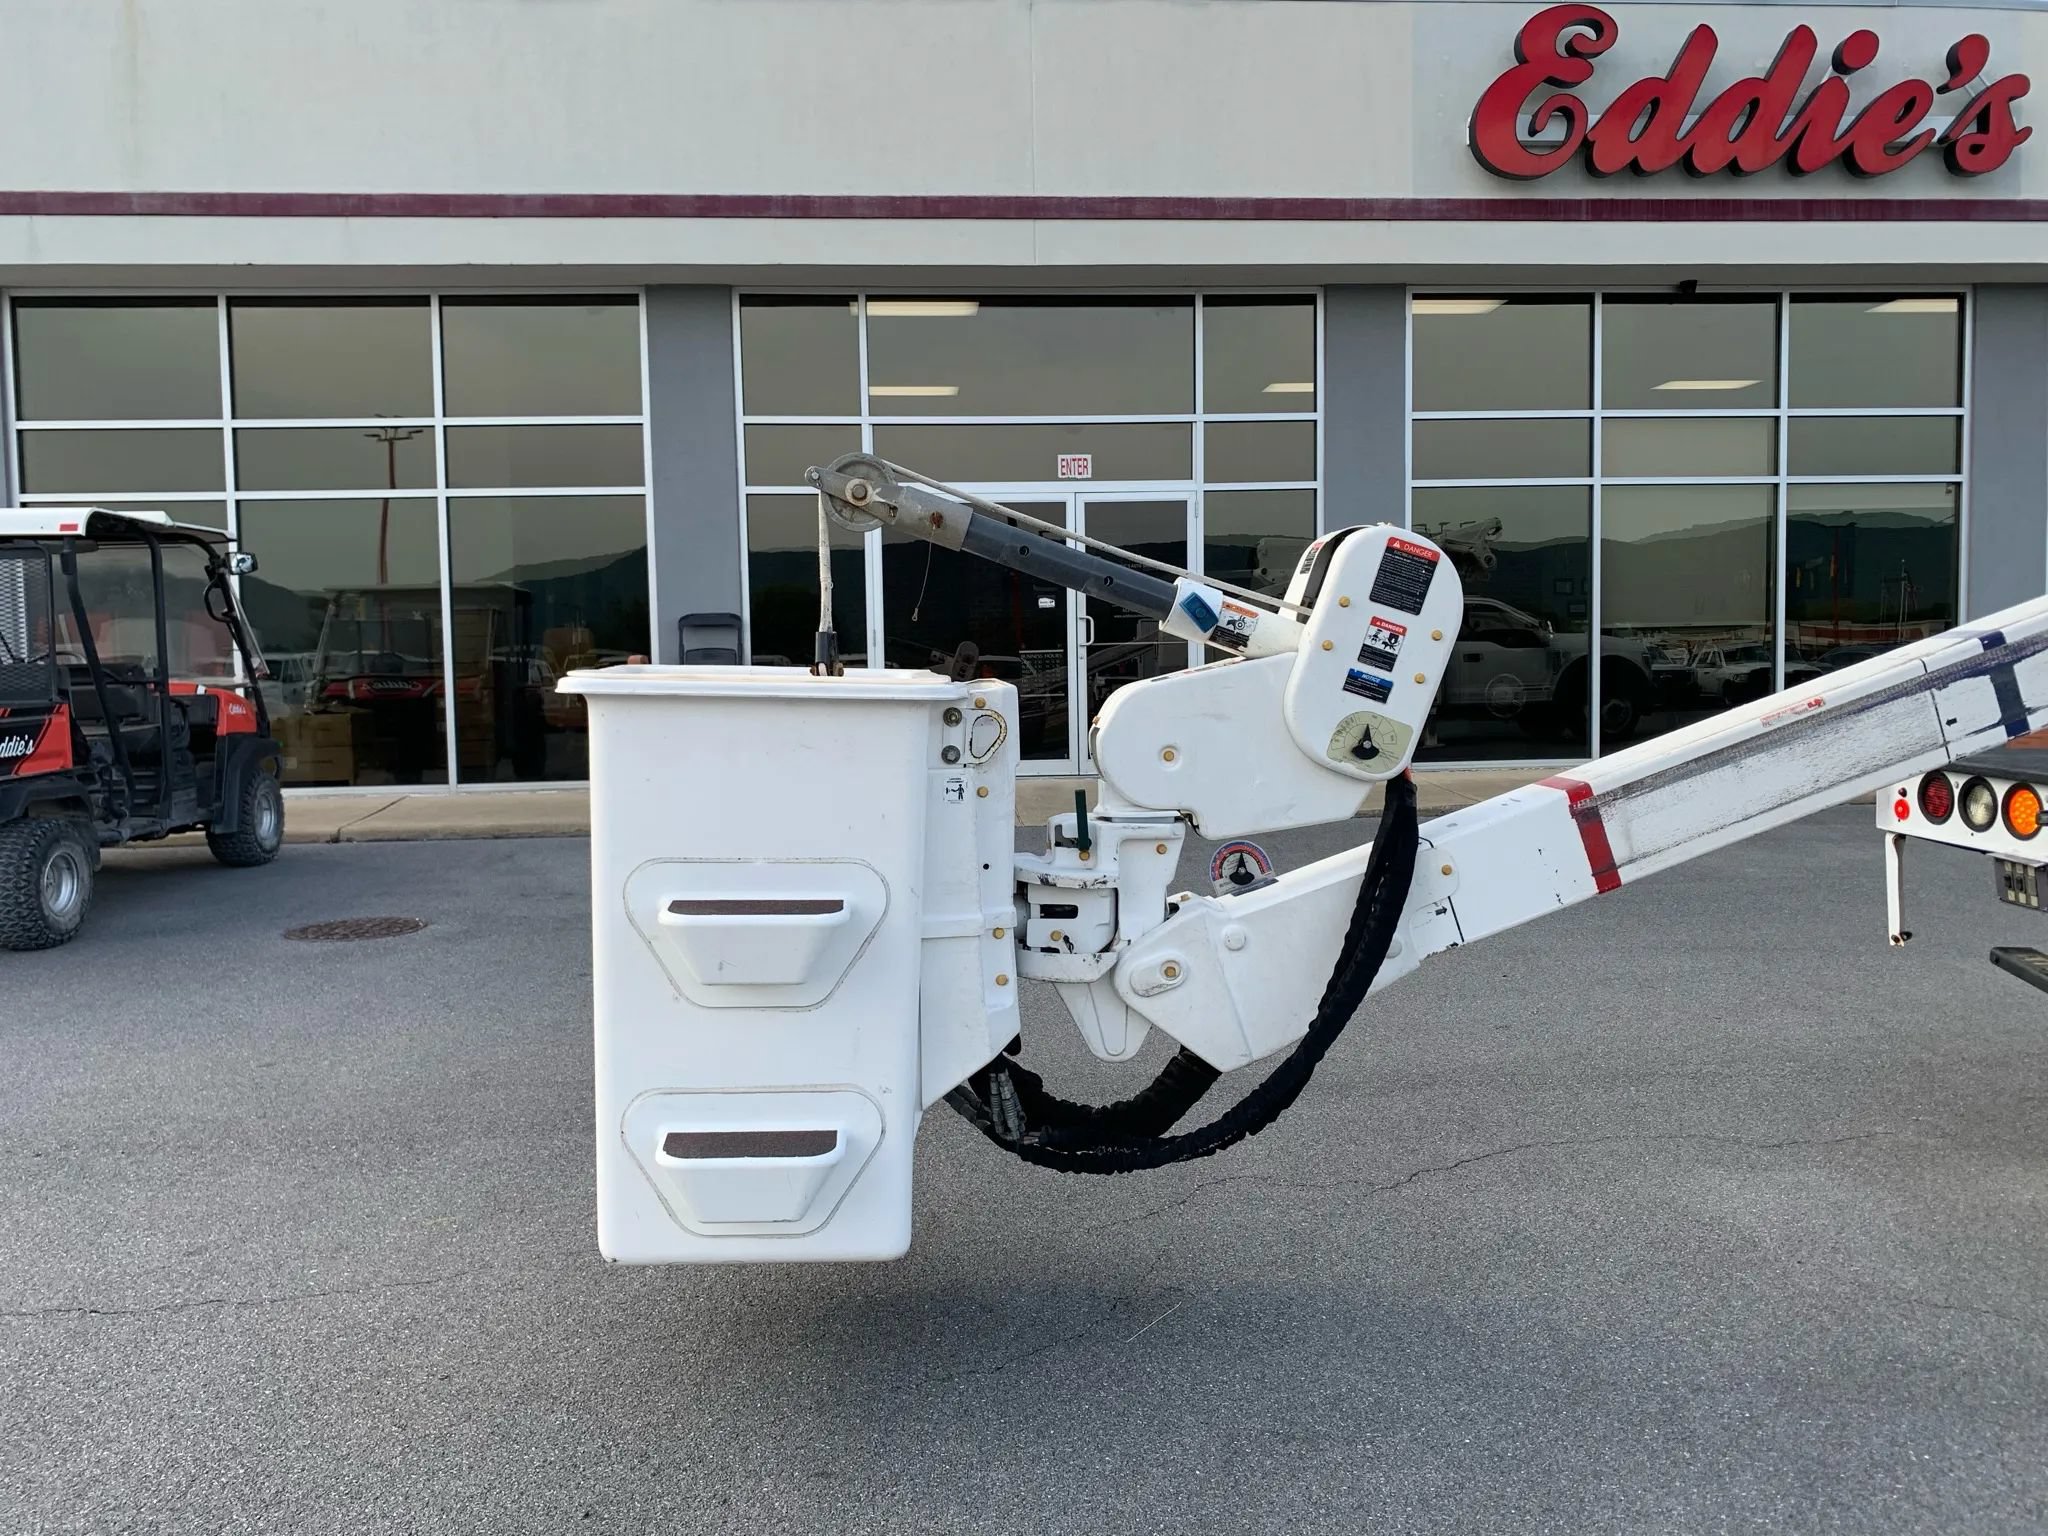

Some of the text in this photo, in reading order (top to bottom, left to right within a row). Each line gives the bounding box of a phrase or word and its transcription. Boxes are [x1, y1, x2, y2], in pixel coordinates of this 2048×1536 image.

[1470, 4, 2033, 180] Eddie's
[1061, 457, 1089, 476] ENTER
[1403, 543, 1433, 558] DANGER
[1381, 622, 1404, 633] DANGER
[1361, 673, 1381, 683] NOTICE
[0, 734, 35, 758] ddie's
